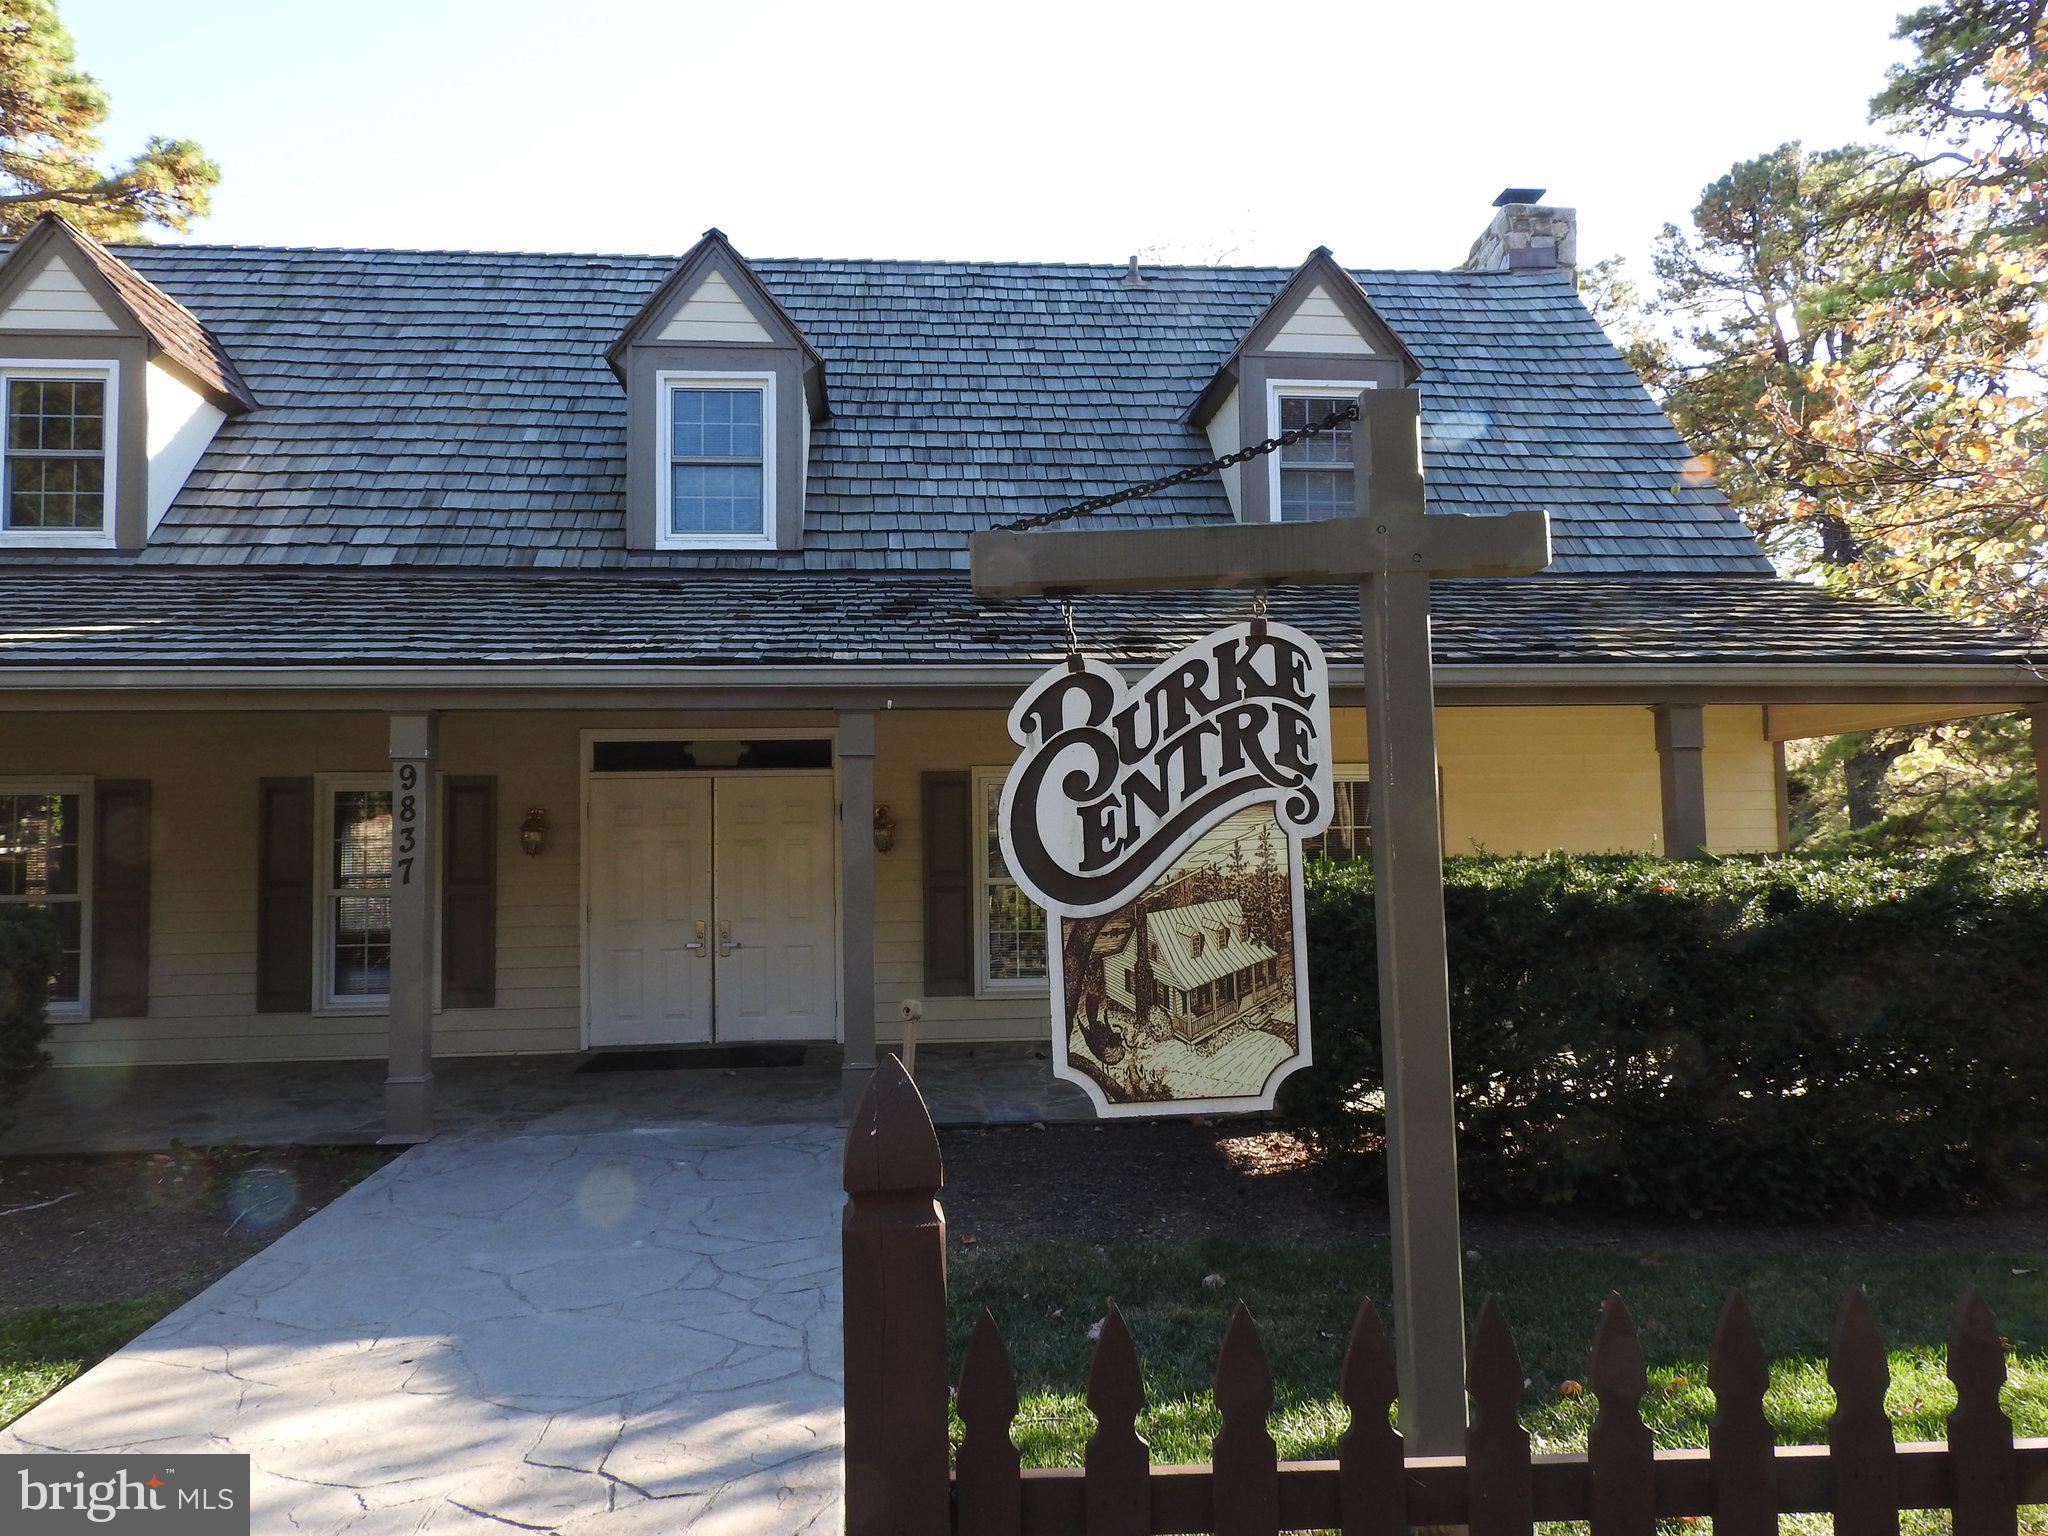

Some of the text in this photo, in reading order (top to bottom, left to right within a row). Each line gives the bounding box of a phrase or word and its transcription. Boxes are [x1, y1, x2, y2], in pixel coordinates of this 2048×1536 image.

[1019, 635, 1317, 765] BURKE
[398, 763, 417, 885] 9837
[1010, 703, 1320, 906] CENTRE
